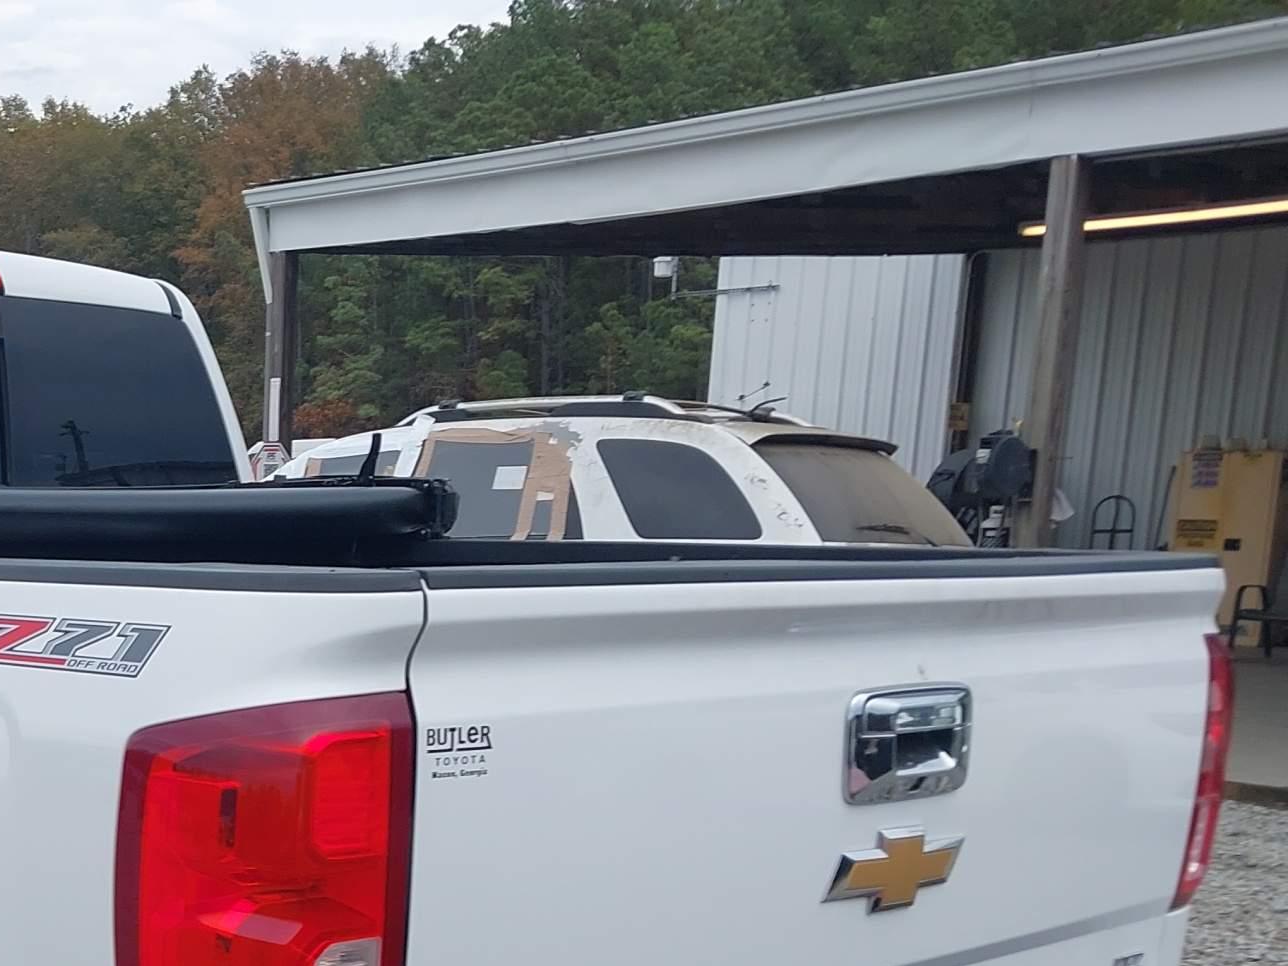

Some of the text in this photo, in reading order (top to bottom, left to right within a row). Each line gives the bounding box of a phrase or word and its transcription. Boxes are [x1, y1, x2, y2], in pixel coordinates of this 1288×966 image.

[66, 659, 139, 673] OFF ROAD
[435, 755, 486, 767] TOYOTA
